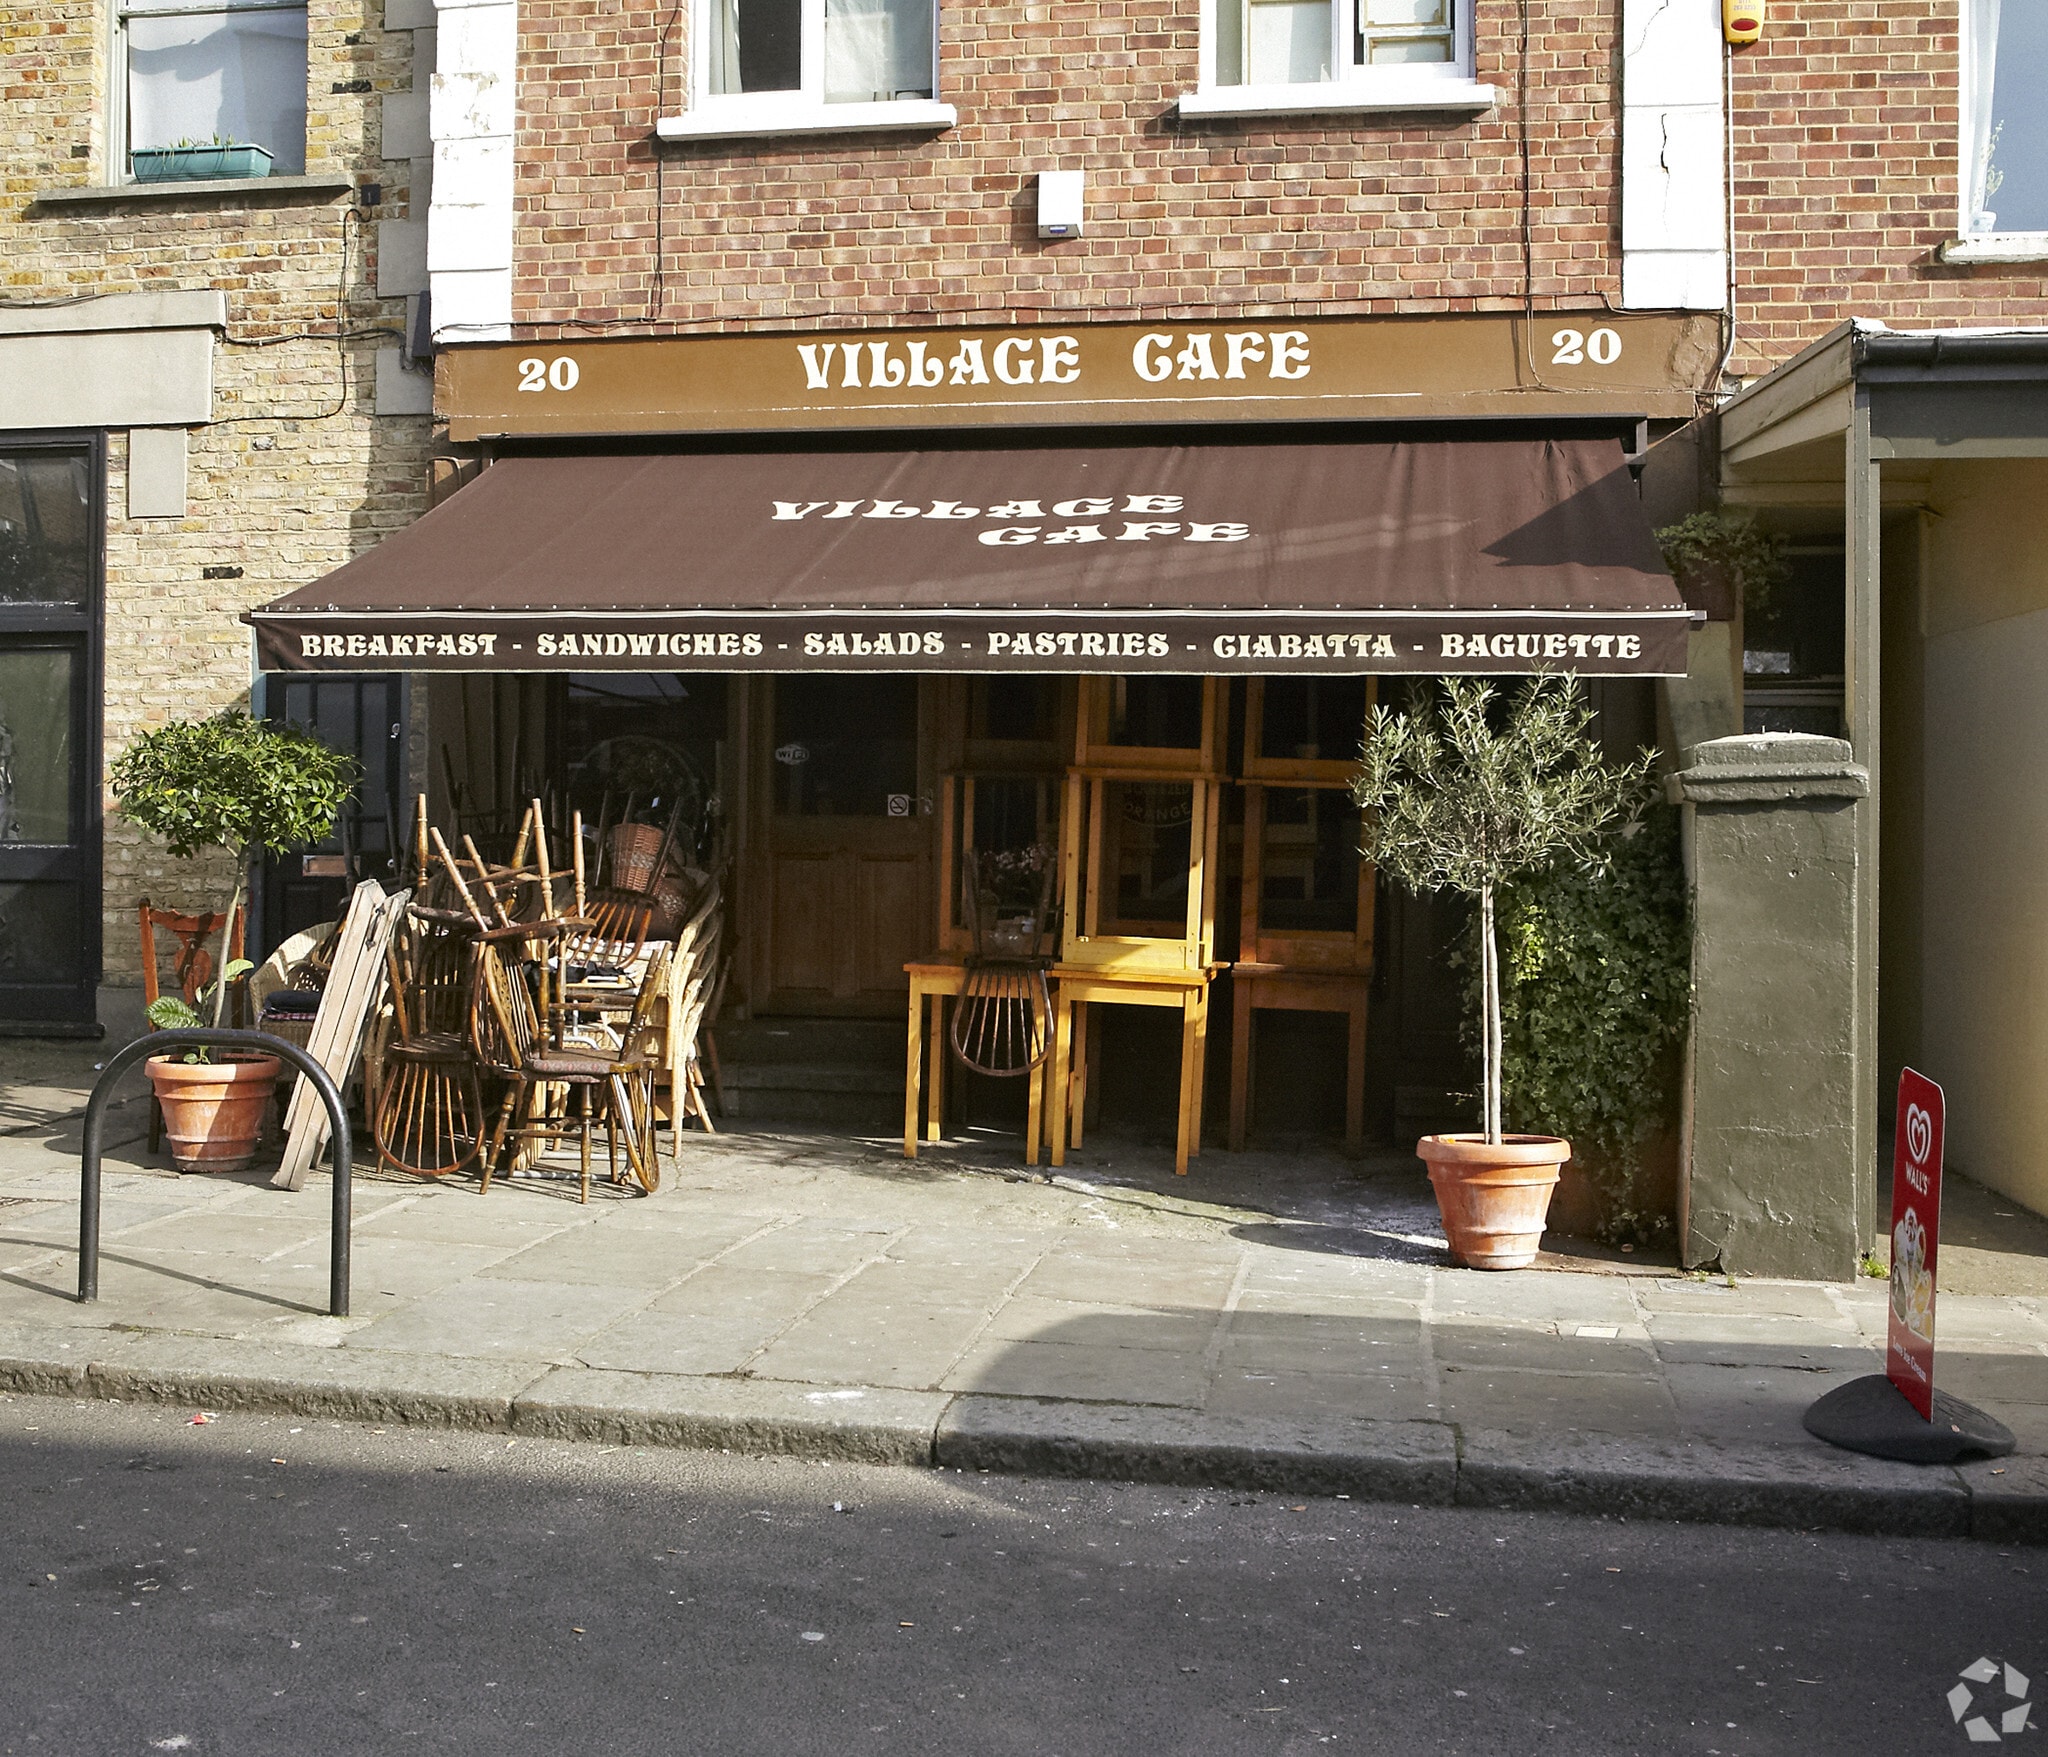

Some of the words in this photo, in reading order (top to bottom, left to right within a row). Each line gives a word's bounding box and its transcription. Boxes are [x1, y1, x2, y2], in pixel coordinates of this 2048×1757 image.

[796, 335, 1081, 390] VILLAGE
[1132, 330, 1311, 382] CAFE
[1551, 328, 1623, 365] 20
[517, 356, 580, 392] 20
[771, 494, 1185, 521] VILLAGE
[977, 521, 1251, 546] CAFE
[299, 633, 498, 657] BREAKFAST
[536, 633, 764, 656] SANDWICHES
[803, 632, 945, 656] SALADS
[987, 632, 1170, 657] PASTRIES
[1213, 634, 1397, 659] CIABATTA
[1440, 633, 1642, 659] BAGUETTE
[1905, 1160, 1928, 1197] WALL'S
